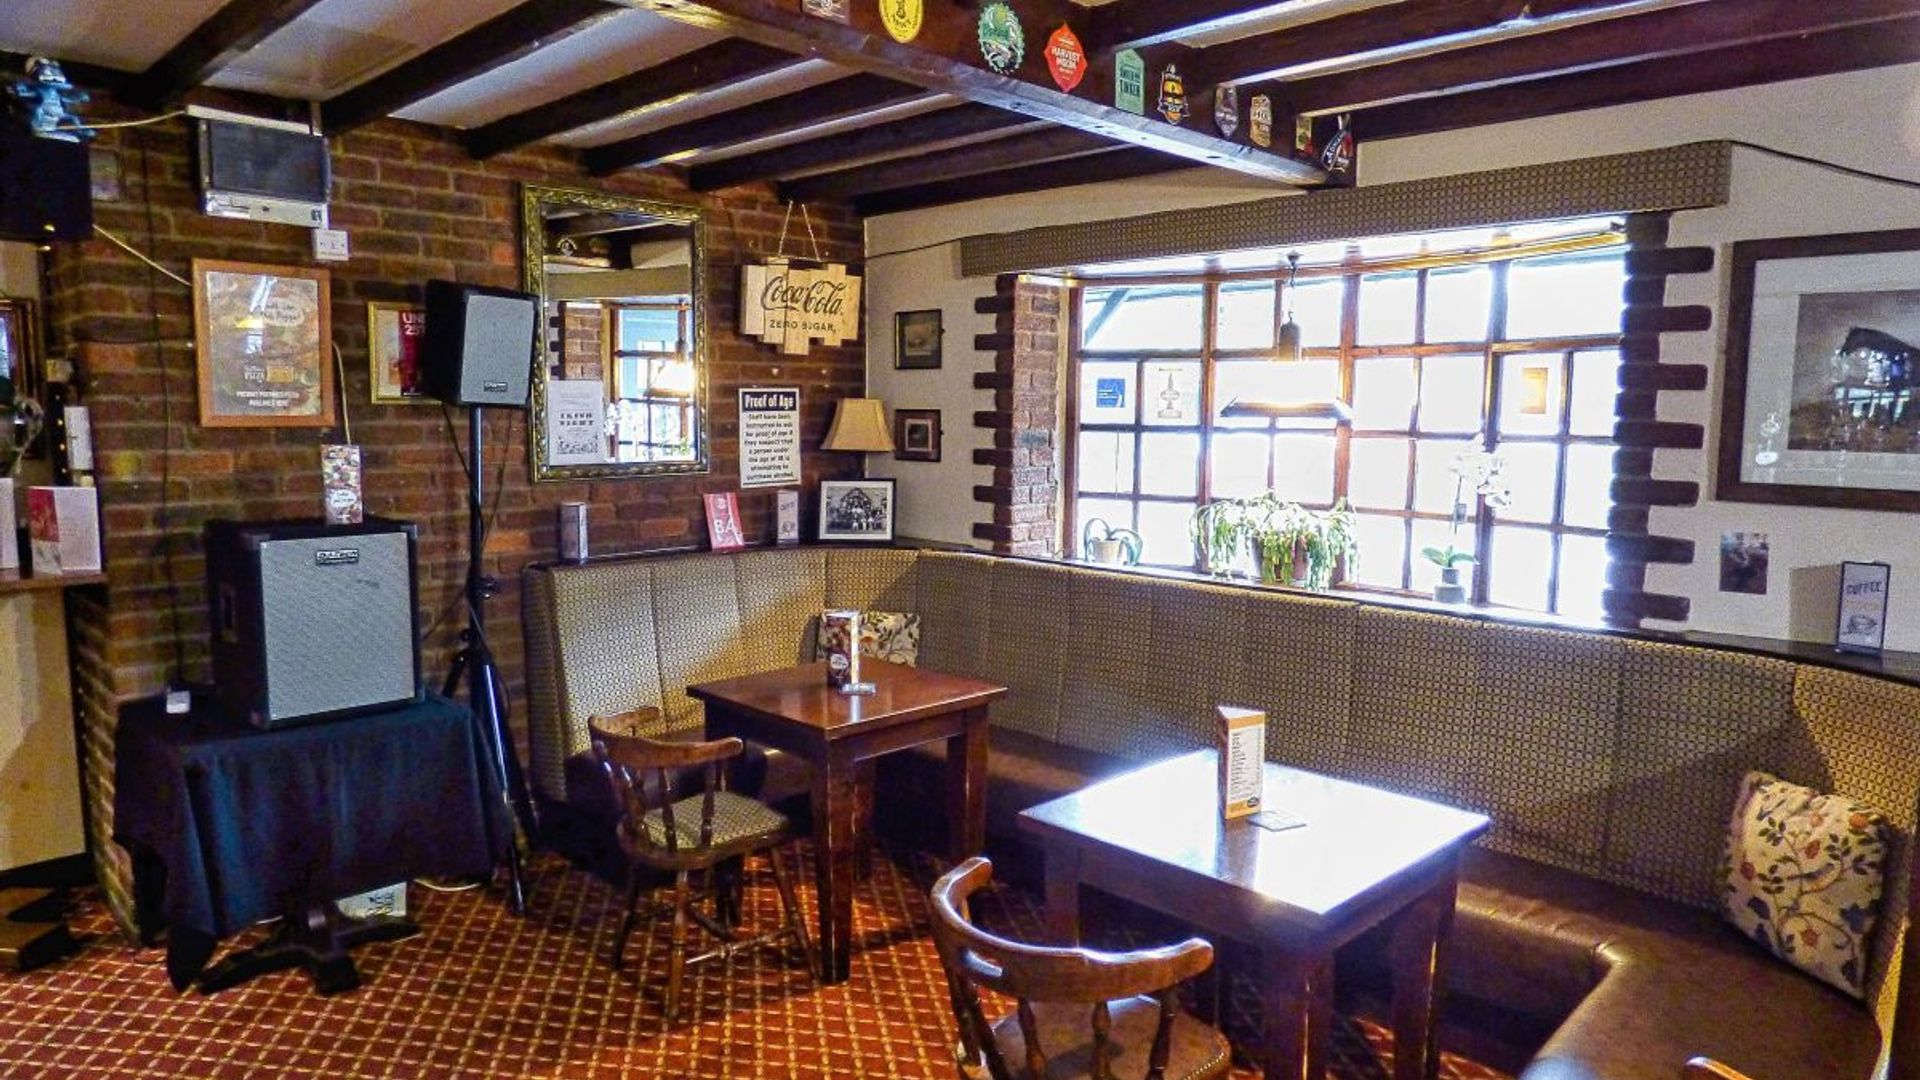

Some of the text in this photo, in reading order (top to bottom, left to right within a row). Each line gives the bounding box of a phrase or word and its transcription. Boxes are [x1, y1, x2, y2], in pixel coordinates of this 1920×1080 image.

[761, 276, 847, 315] Coca-Cola
[769, 319, 798, 329] ZERO
[745, 394, 794, 410] Proof of Age
